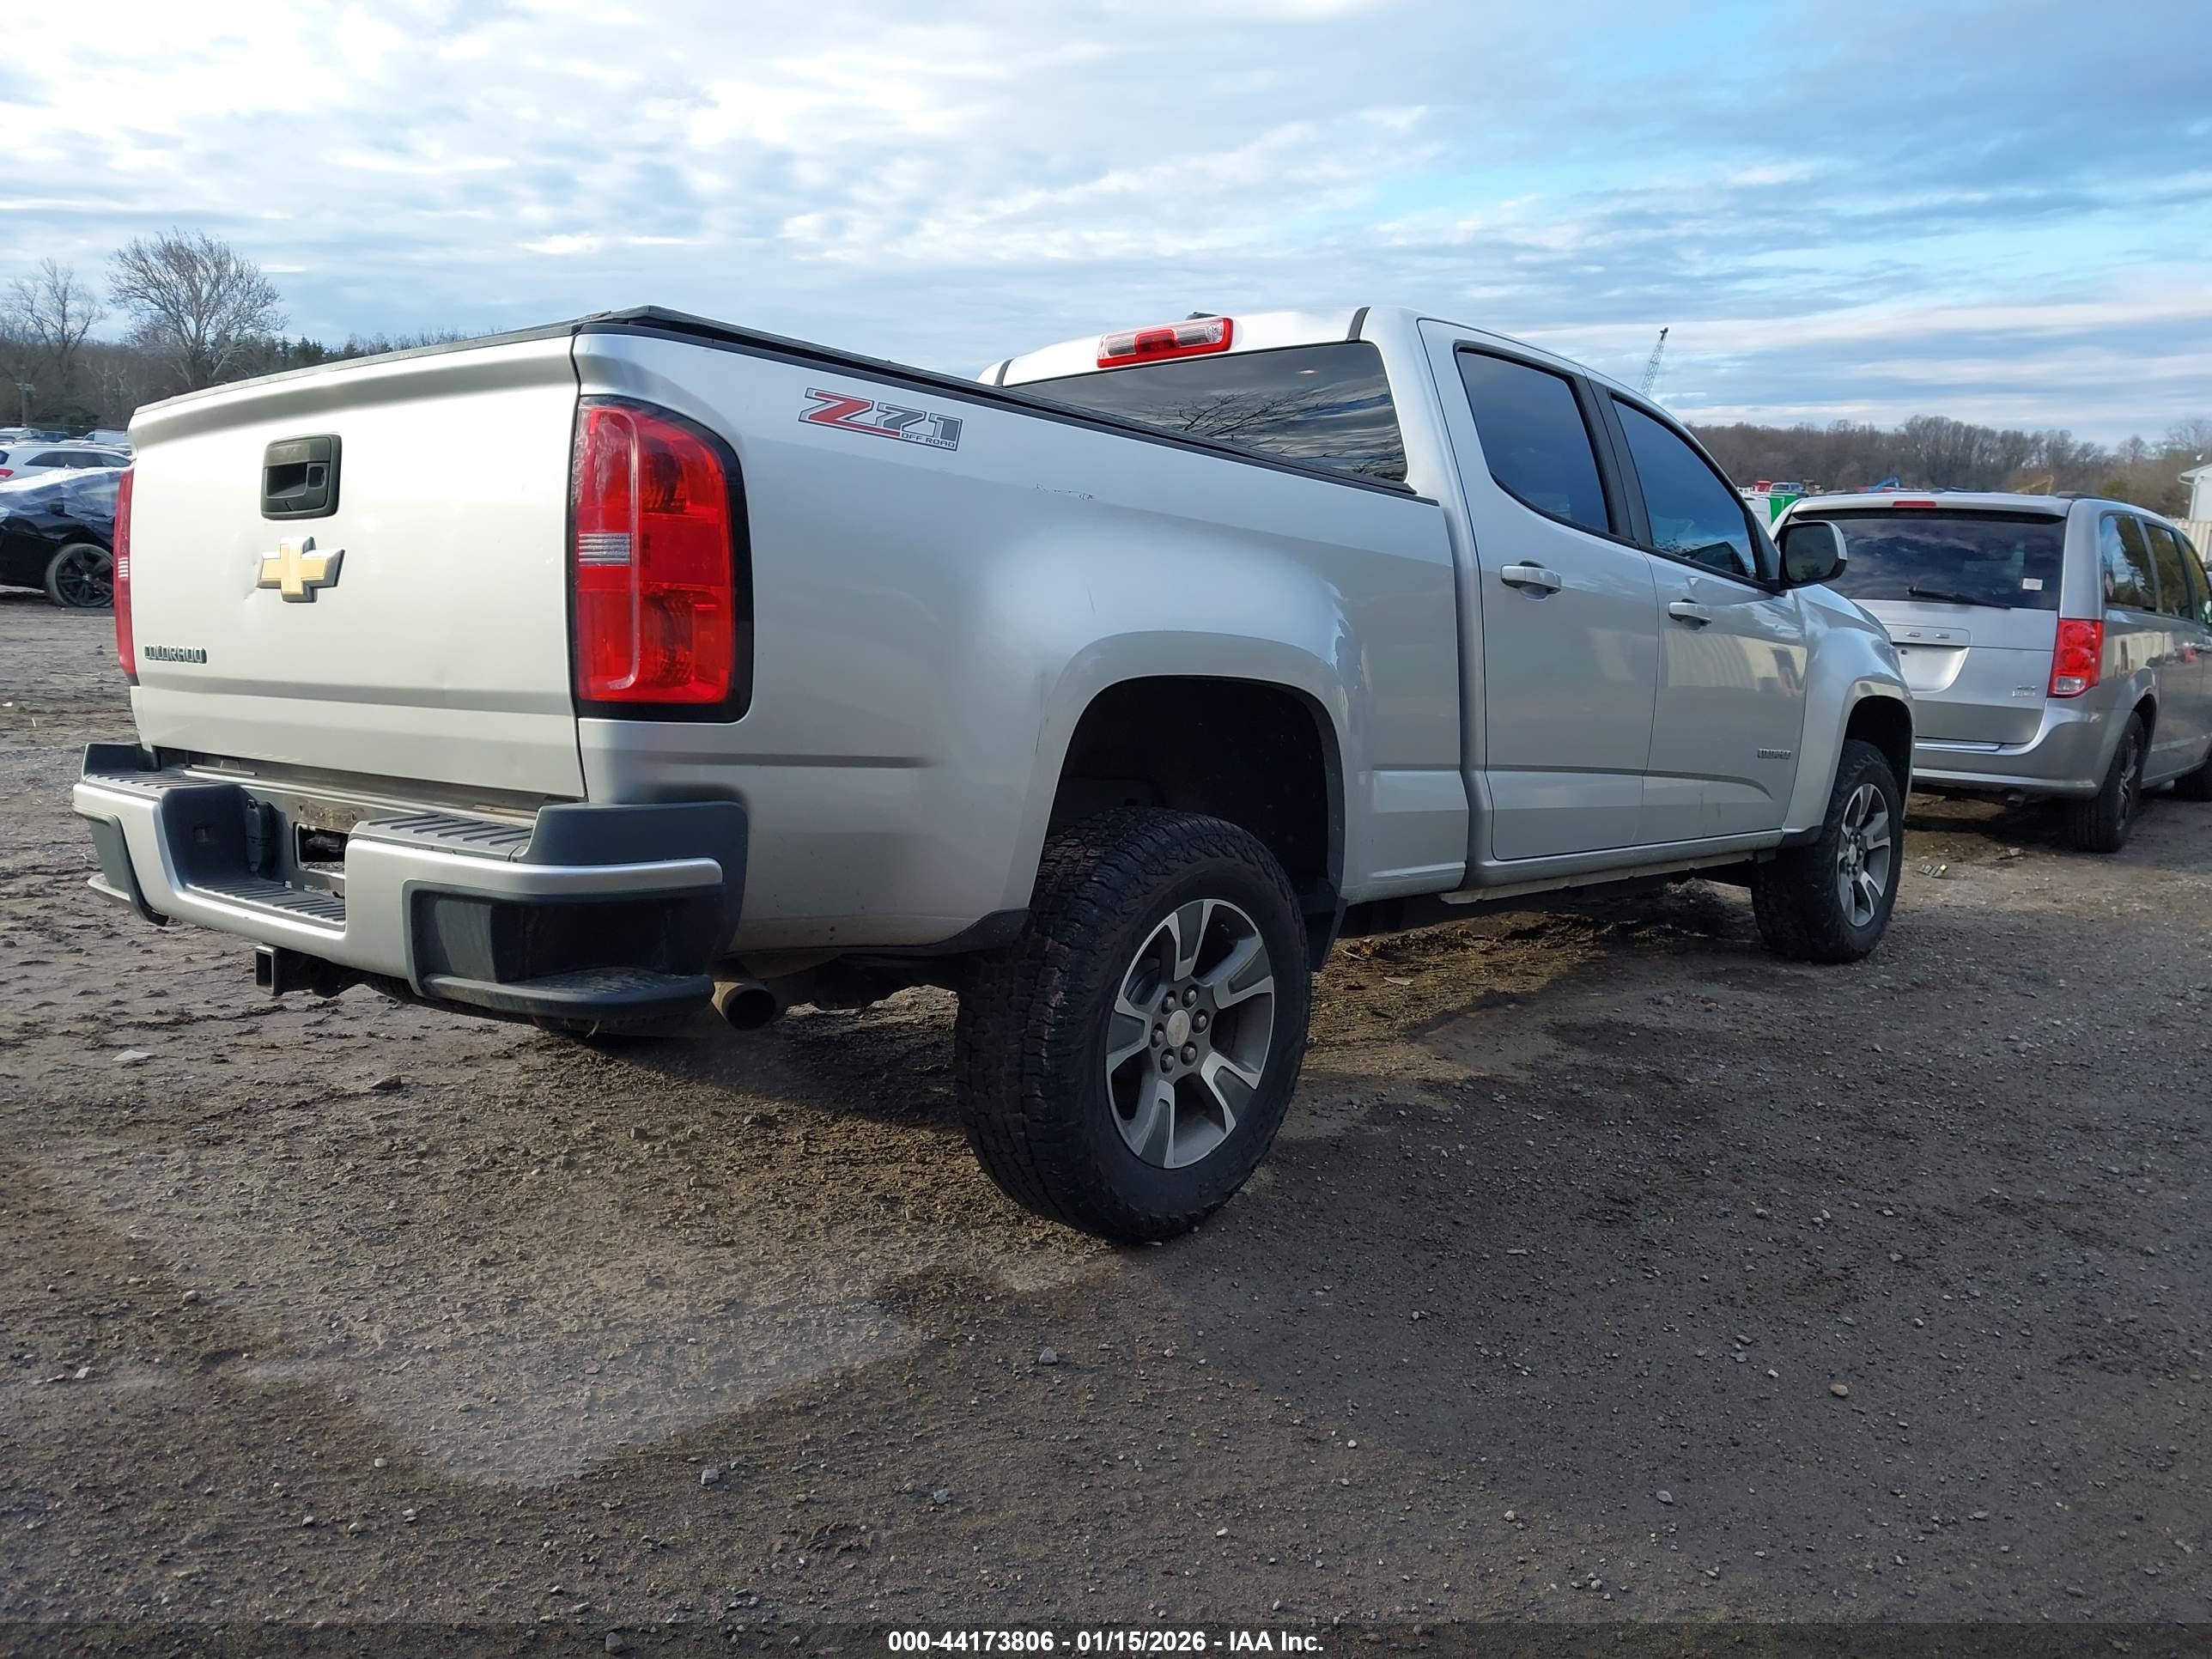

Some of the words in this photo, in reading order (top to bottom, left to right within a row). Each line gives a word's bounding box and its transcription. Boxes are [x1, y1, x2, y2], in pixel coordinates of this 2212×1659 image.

[799, 387, 963, 449] Z71
[902, 433, 923, 442] OFF
[926, 438, 955, 448] ROAD
